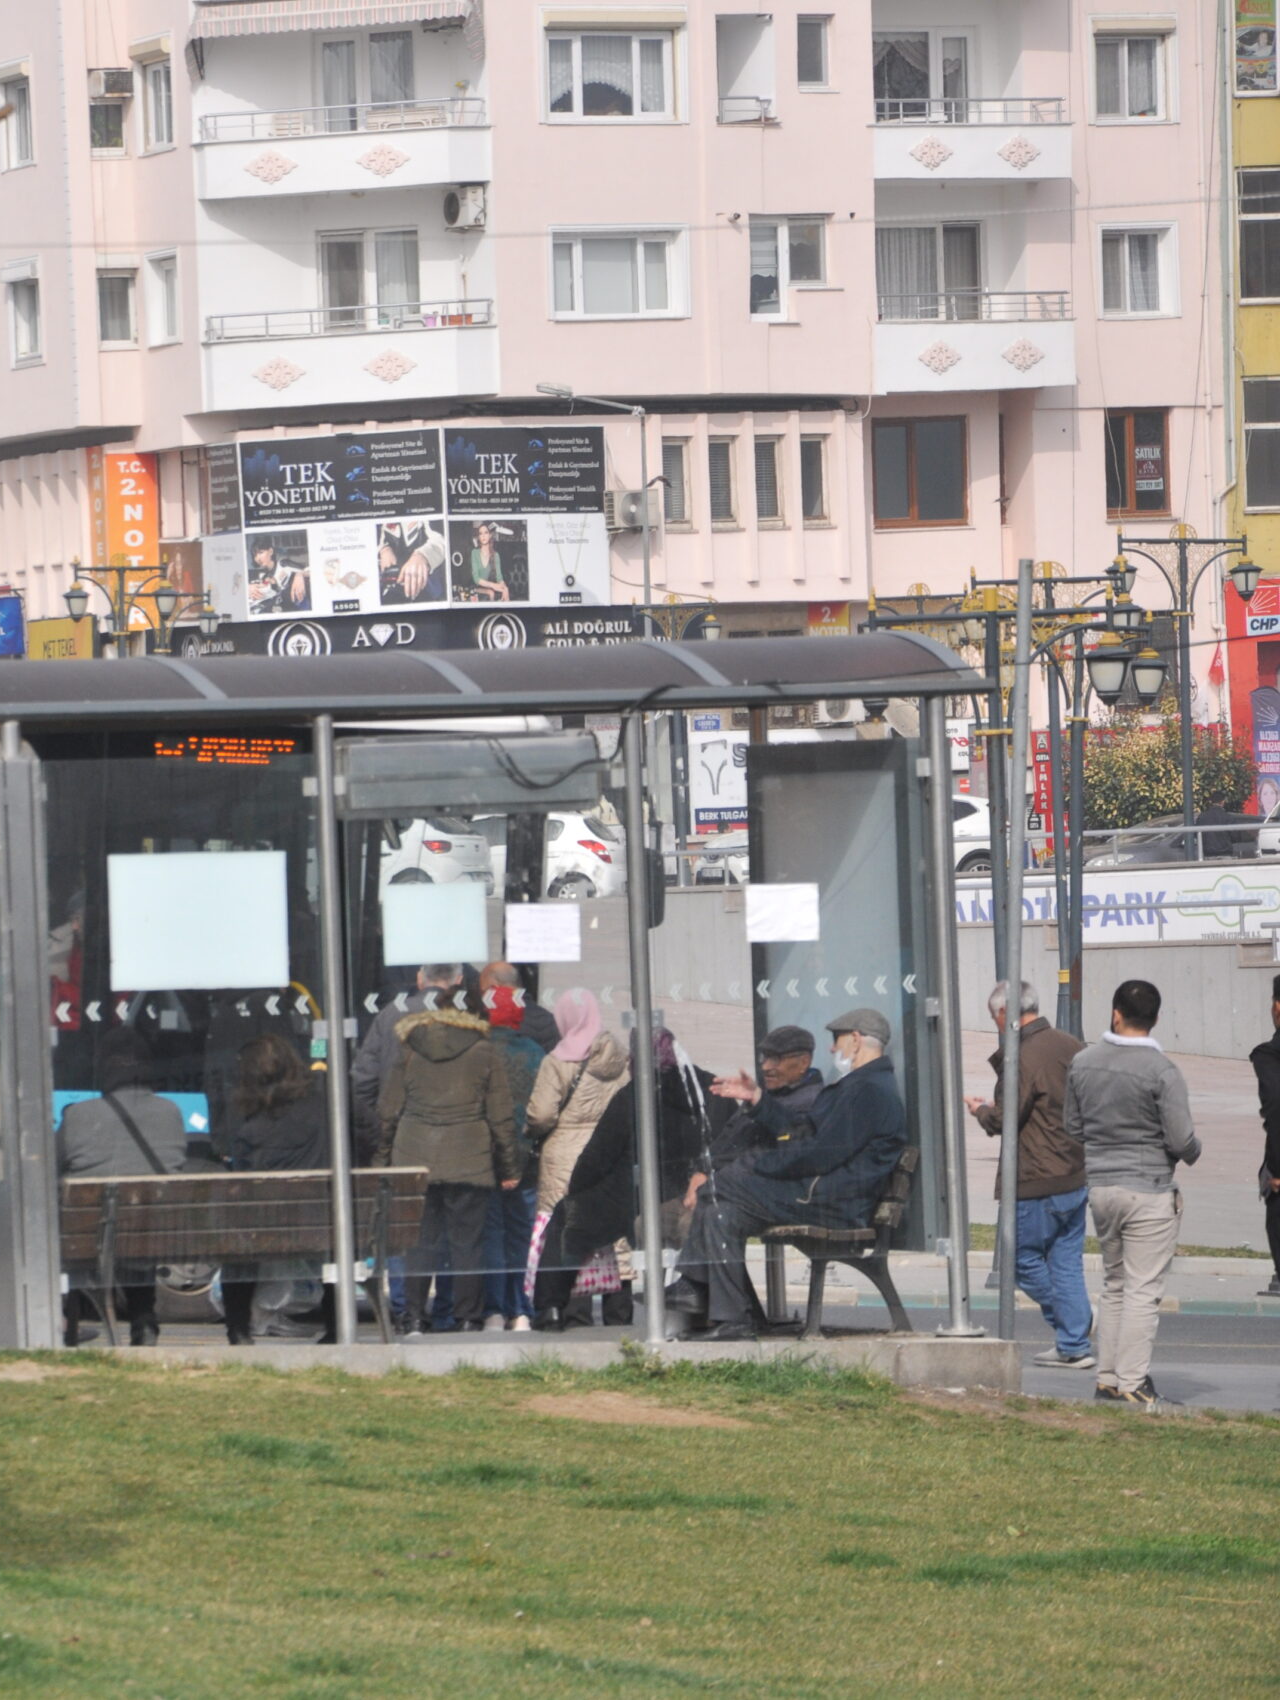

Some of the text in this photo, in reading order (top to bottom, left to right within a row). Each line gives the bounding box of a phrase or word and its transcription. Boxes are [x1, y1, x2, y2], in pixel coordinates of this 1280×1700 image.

[1135, 447, 1161, 459] SATILIK
[117, 461, 147, 473] T.C.
[475, 454, 519, 475] TEK
[279, 462, 335, 486] TEK
[120, 479, 145, 496] 2.
[448, 475, 520, 495] YÖNETİM
[245, 484, 337, 508] YÖNETİM
[821, 606, 836, 623] 2.
[546, 619, 632, 635] ALİ DOĞRUL
[1250, 616, 1279, 632] CHP
[352, 622, 416, 648] A D
[1039, 764, 1049, 810] EMLAK
[699, 811, 719, 821] BERK
